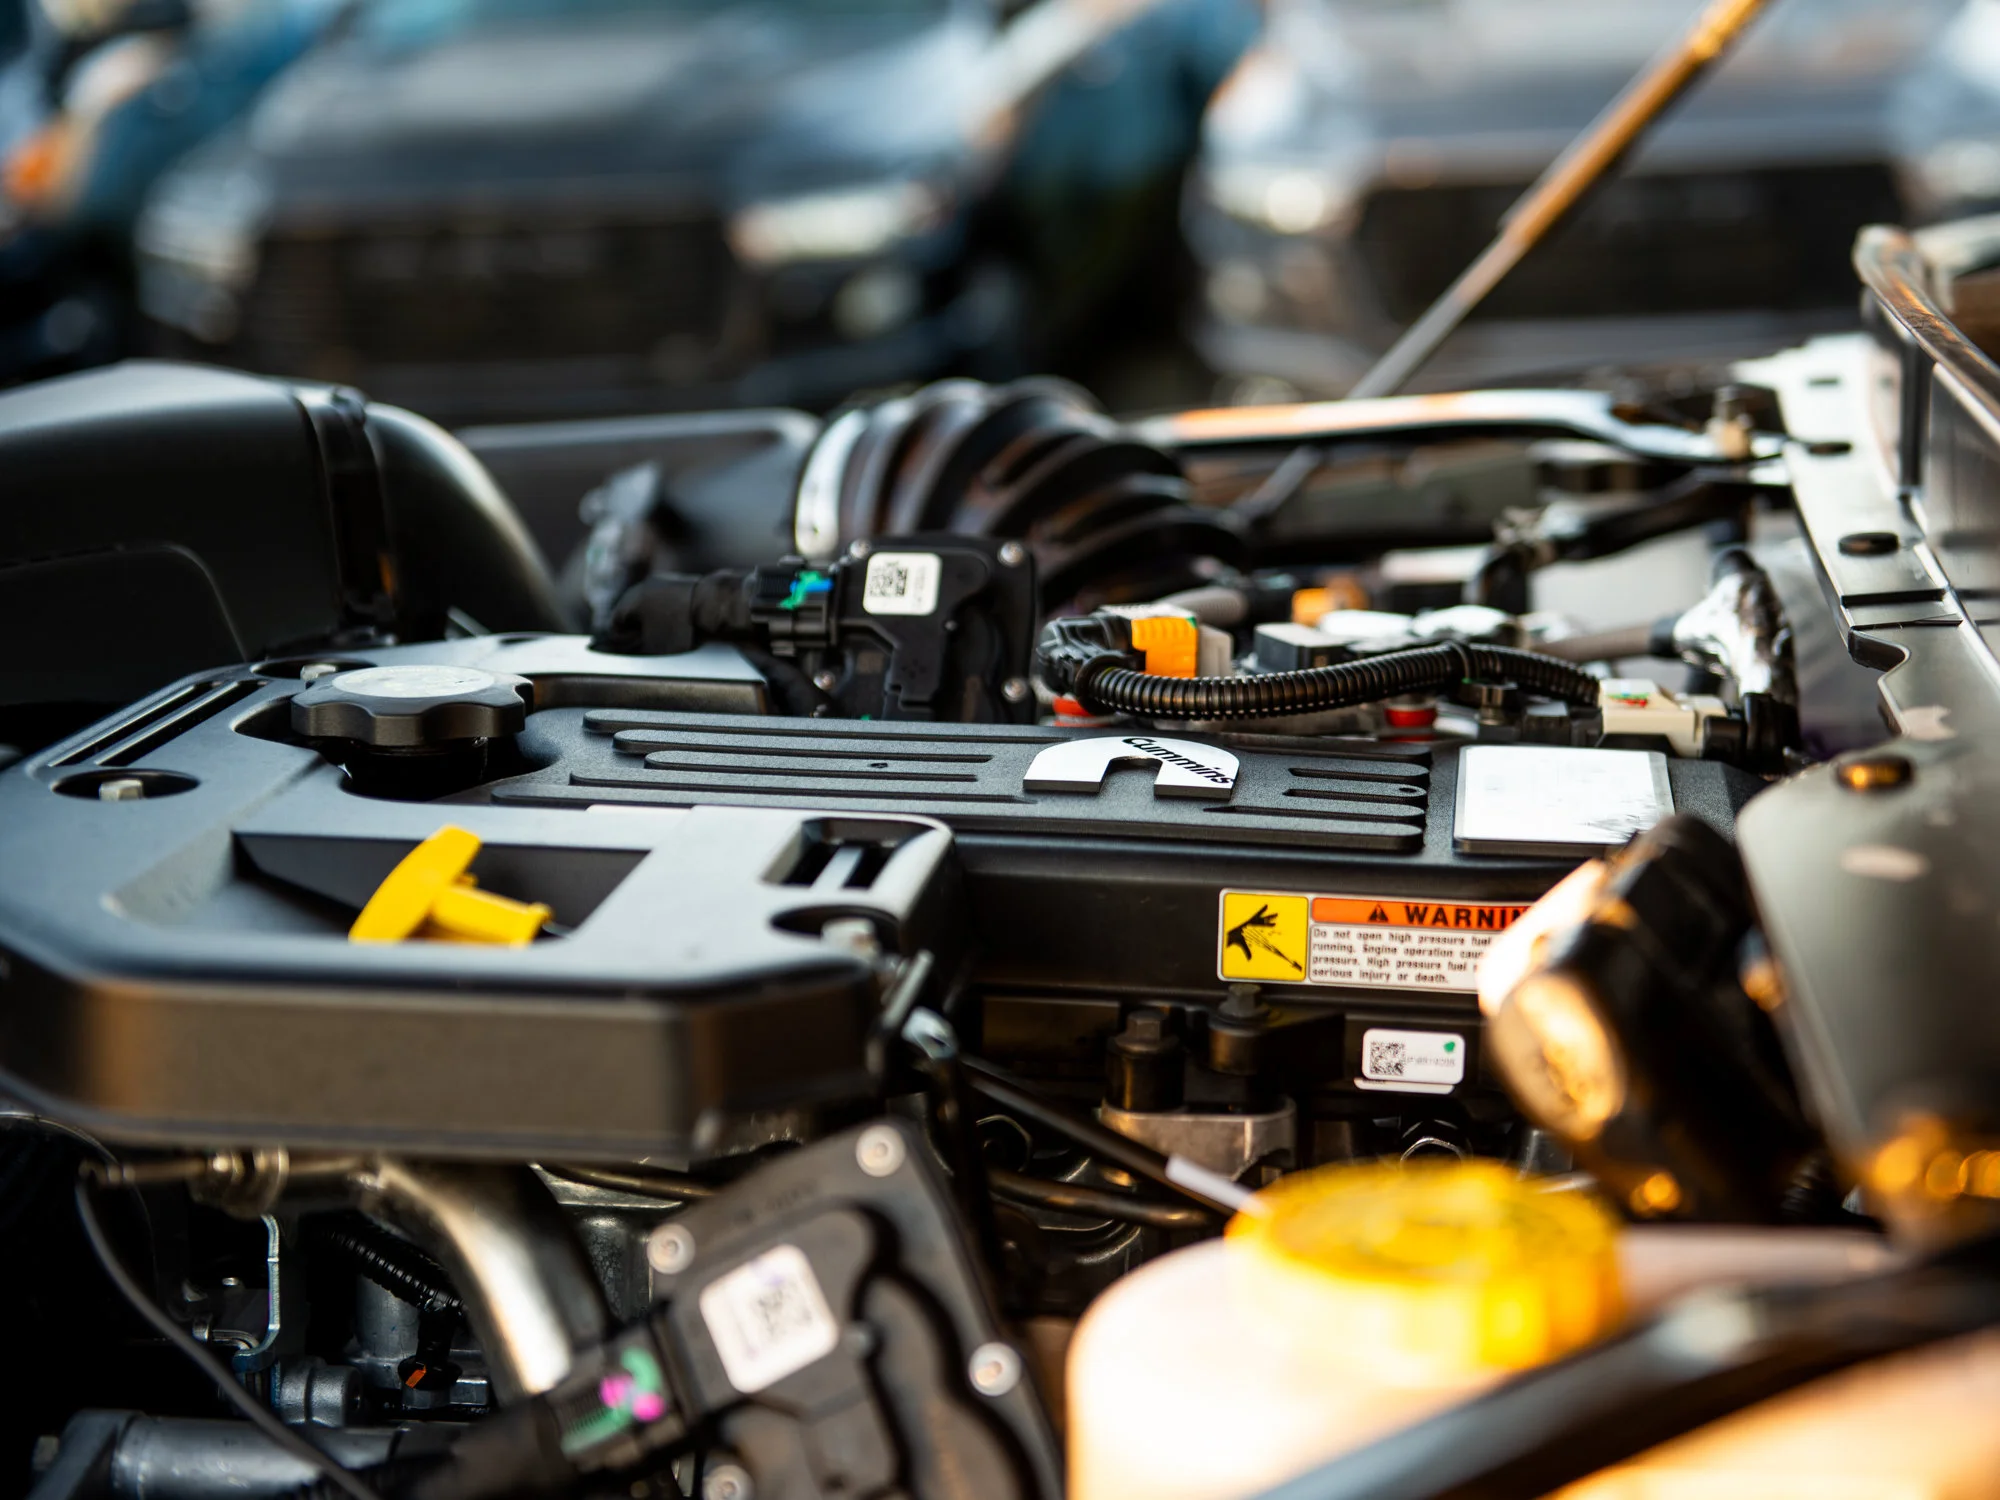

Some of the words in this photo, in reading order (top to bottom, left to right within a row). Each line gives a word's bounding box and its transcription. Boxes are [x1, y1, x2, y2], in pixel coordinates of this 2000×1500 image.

[1121, 737, 1234, 784] Cummins
[1313, 928, 1327, 938] Do
[1334, 930, 1350, 940] not
[1357, 932, 1382, 942] open
[1388, 931, 1412, 944] high
[1418, 935, 1465, 946] pressure
[1472, 936, 1492, 946] fuel
[1313, 943, 1355, 953] running.
[1362, 943, 1398, 955] Engine
[1403, 947, 1454, 958] operation
[1313, 956, 1360, 965] pressure.
[1367, 957, 1390, 968] High
[1396, 959, 1441, 970] pressure
[1447, 960, 1468, 972] fuel
[1313, 967, 1353, 978] serious
[1360, 970, 1391, 981] injury
[1397, 972, 1408, 982] or
[1415, 972, 1448, 983] death.
